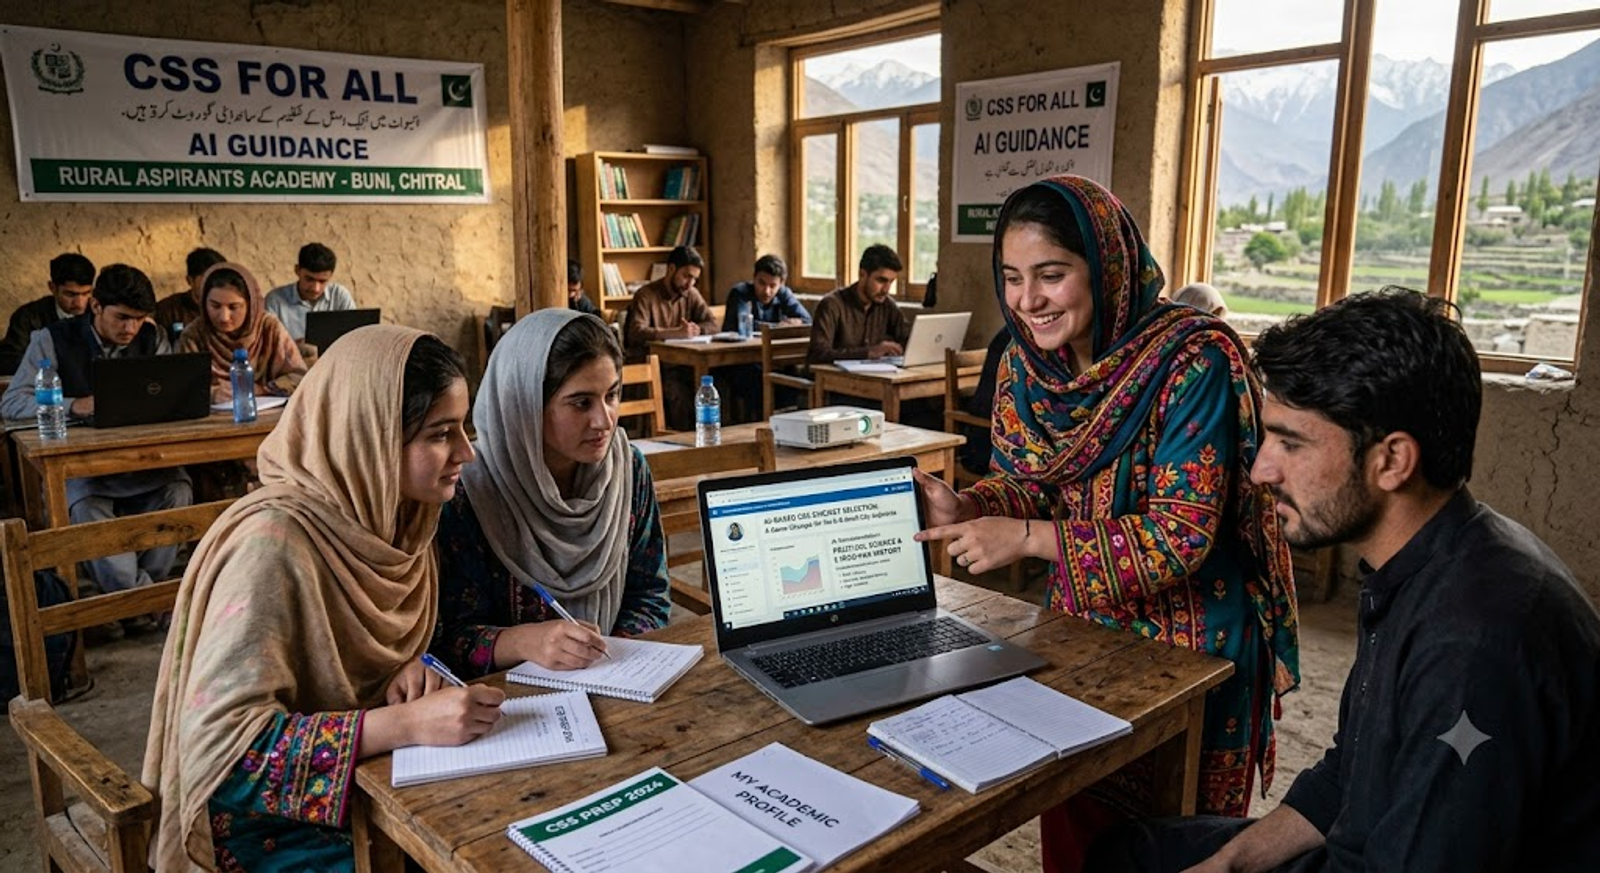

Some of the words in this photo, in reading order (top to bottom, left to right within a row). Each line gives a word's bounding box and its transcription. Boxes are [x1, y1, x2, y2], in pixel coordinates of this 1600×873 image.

[124, 53, 221, 93] CSS
[238, 60, 328, 99] FOR
[342, 69, 418, 104] ALL
[987, 97, 1014, 117] CSS
[1017, 93, 1047, 113] FOR
[1050, 90, 1080, 110] ALL
[188, 133, 217, 155] AI
[227, 134, 369, 160] GUIDANCE
[974, 132, 990, 155] AI
[995, 125, 1090, 153] GUIDANCE
[58, 166, 132, 187] RURAL
[135, 167, 245, 188] ASPIRANTS
[249, 169, 337, 189] ACADEMY
[351, 172, 395, 192] BUNI,
[398, 172, 466, 190] CHITRAL
[545, 815, 579, 832] CSS
[579, 797, 623, 820] PREP
[731, 771, 759, 785] MY
[755, 784, 840, 828] ACADEMIC
[735, 790, 803, 828] PROFILE
